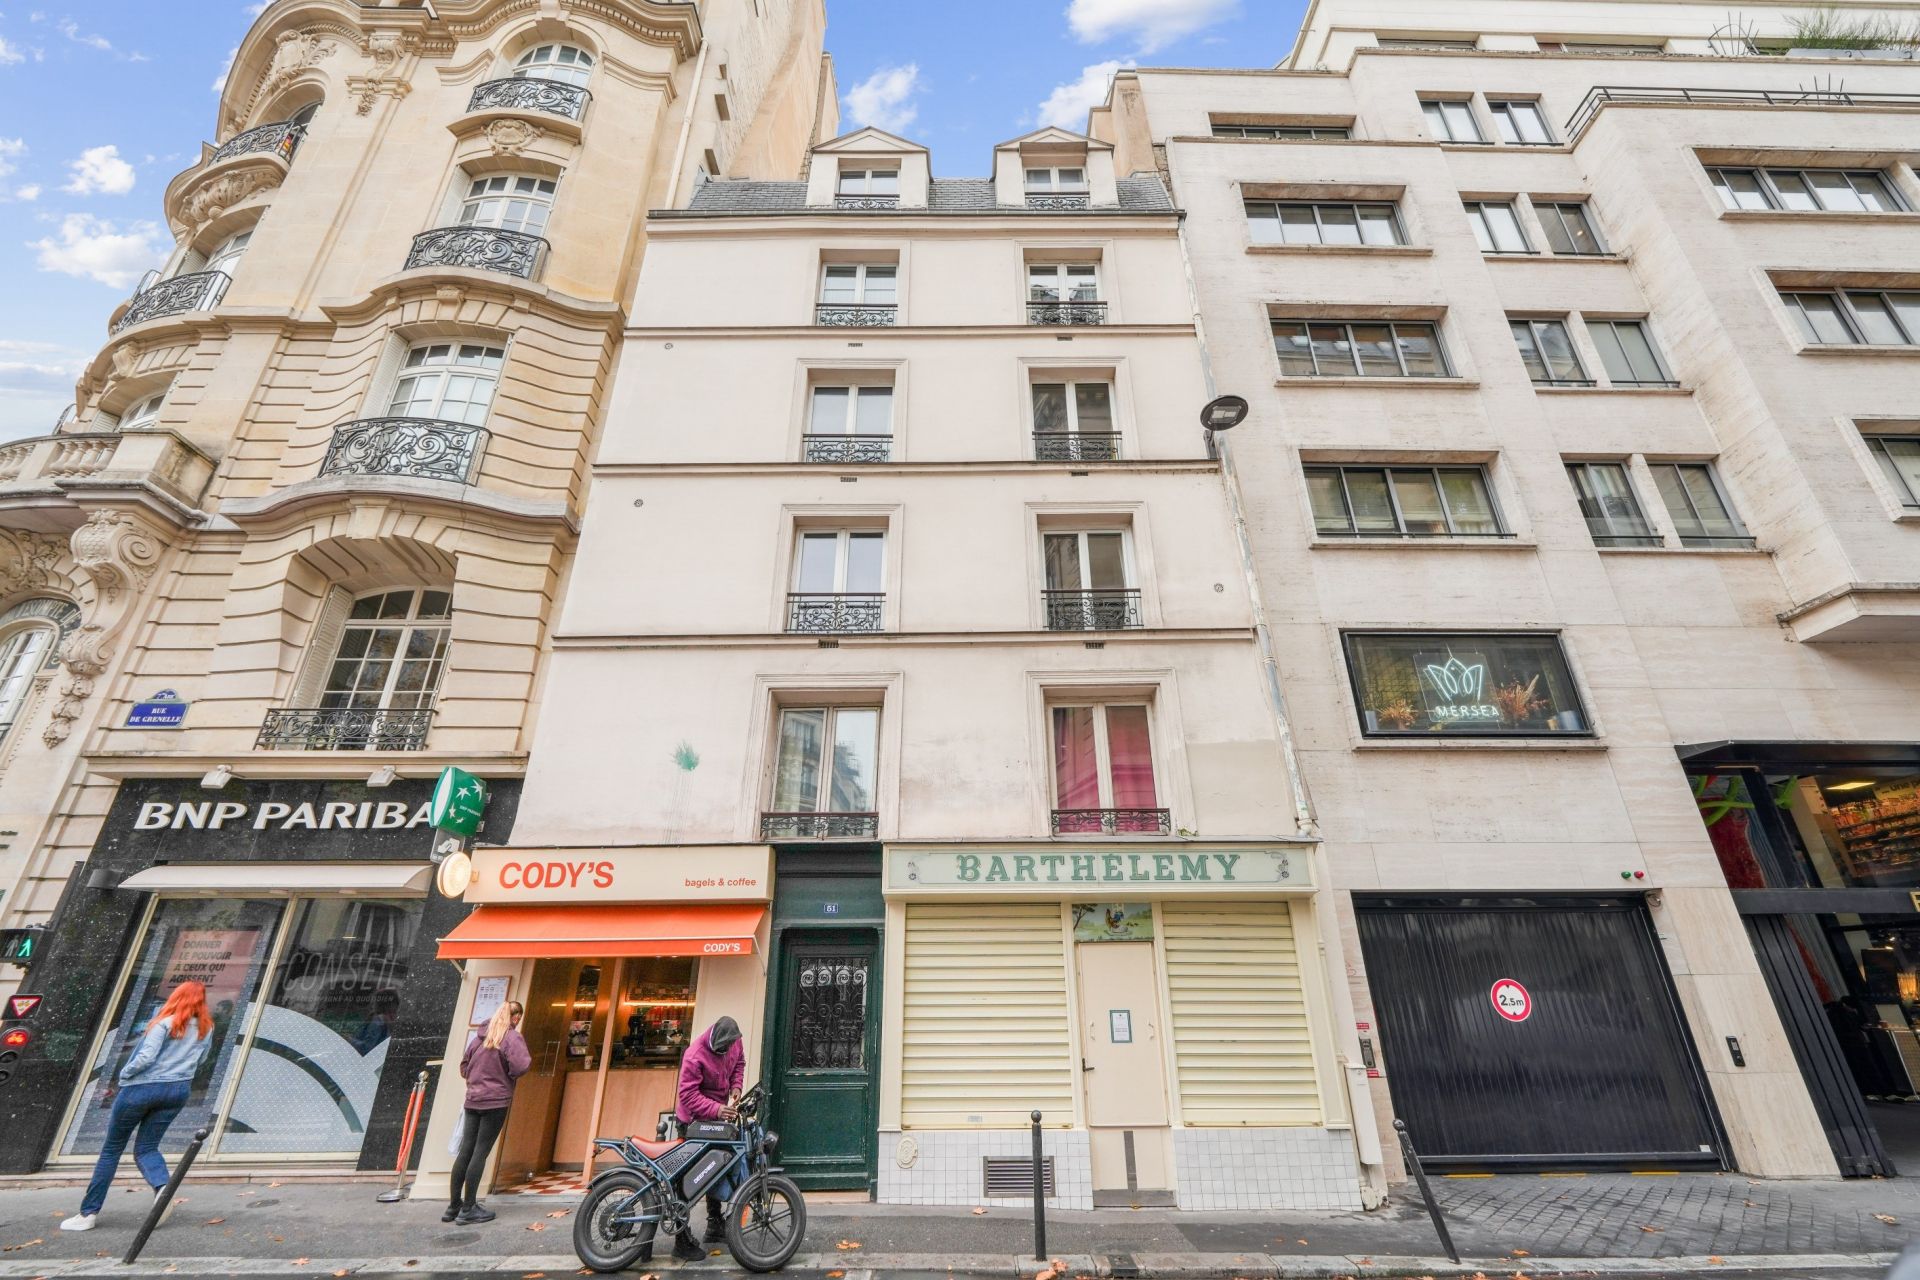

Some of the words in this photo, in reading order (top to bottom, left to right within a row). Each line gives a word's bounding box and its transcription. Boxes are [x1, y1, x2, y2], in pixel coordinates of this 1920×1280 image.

[1437, 705, 1500, 717] MERSEA
[133, 801, 248, 830] BNP
[252, 801, 434, 830] PARIBA
[956, 852, 1241, 882] BARTHÉLEMY
[499, 861, 615, 889] CODY'S
[684, 878, 716, 889] bagels
[718, 878, 725, 887] &
[727, 877, 757, 887] coffee
[183, 941, 223, 949] DONNER
[703, 943, 741, 953] CODY'S
[179, 952, 190, 960] LE
[191, 951, 232, 960] POUVOIR
[182, 963, 208, 972] CEUX
[208, 963, 226, 973] QUI
[282, 952, 399, 991] CONSEIL
[169, 974, 217, 984] AGISSENT
